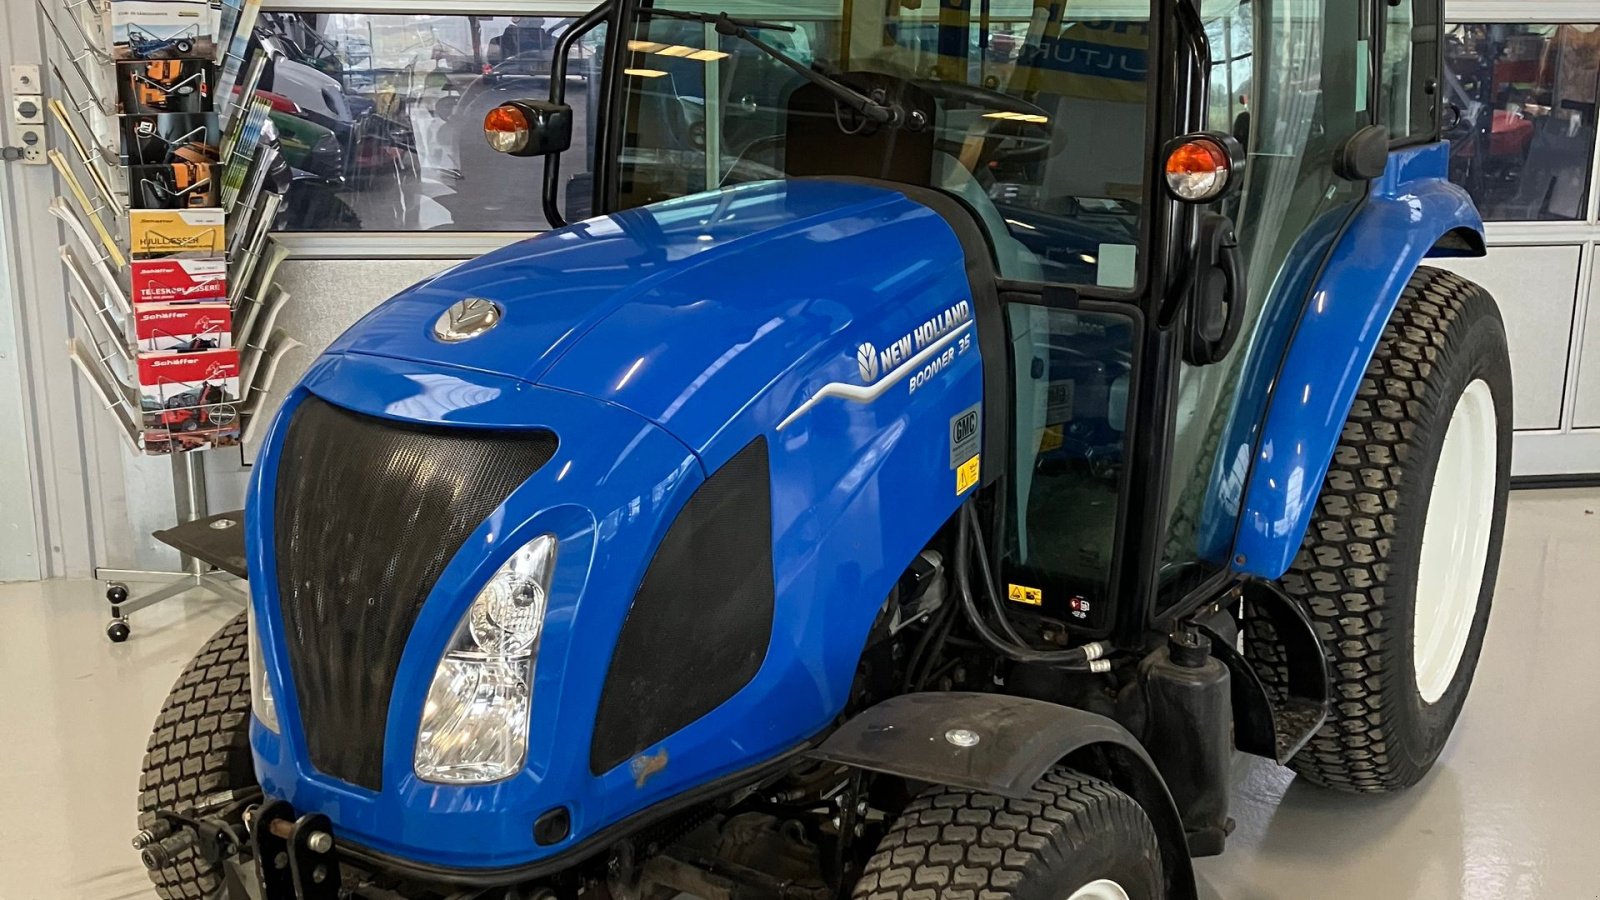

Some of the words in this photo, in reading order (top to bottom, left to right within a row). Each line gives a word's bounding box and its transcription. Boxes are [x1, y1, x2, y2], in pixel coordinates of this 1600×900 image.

[141, 312, 188, 321] Schäffer
[880, 333, 912, 373] NEW
[913, 300, 969, 349] HOLLAND
[151, 358, 199, 367] Schäffer
[908, 346, 955, 395] BOOMER
[958, 333, 971, 356] 35
[956, 413, 975, 440] GMC
